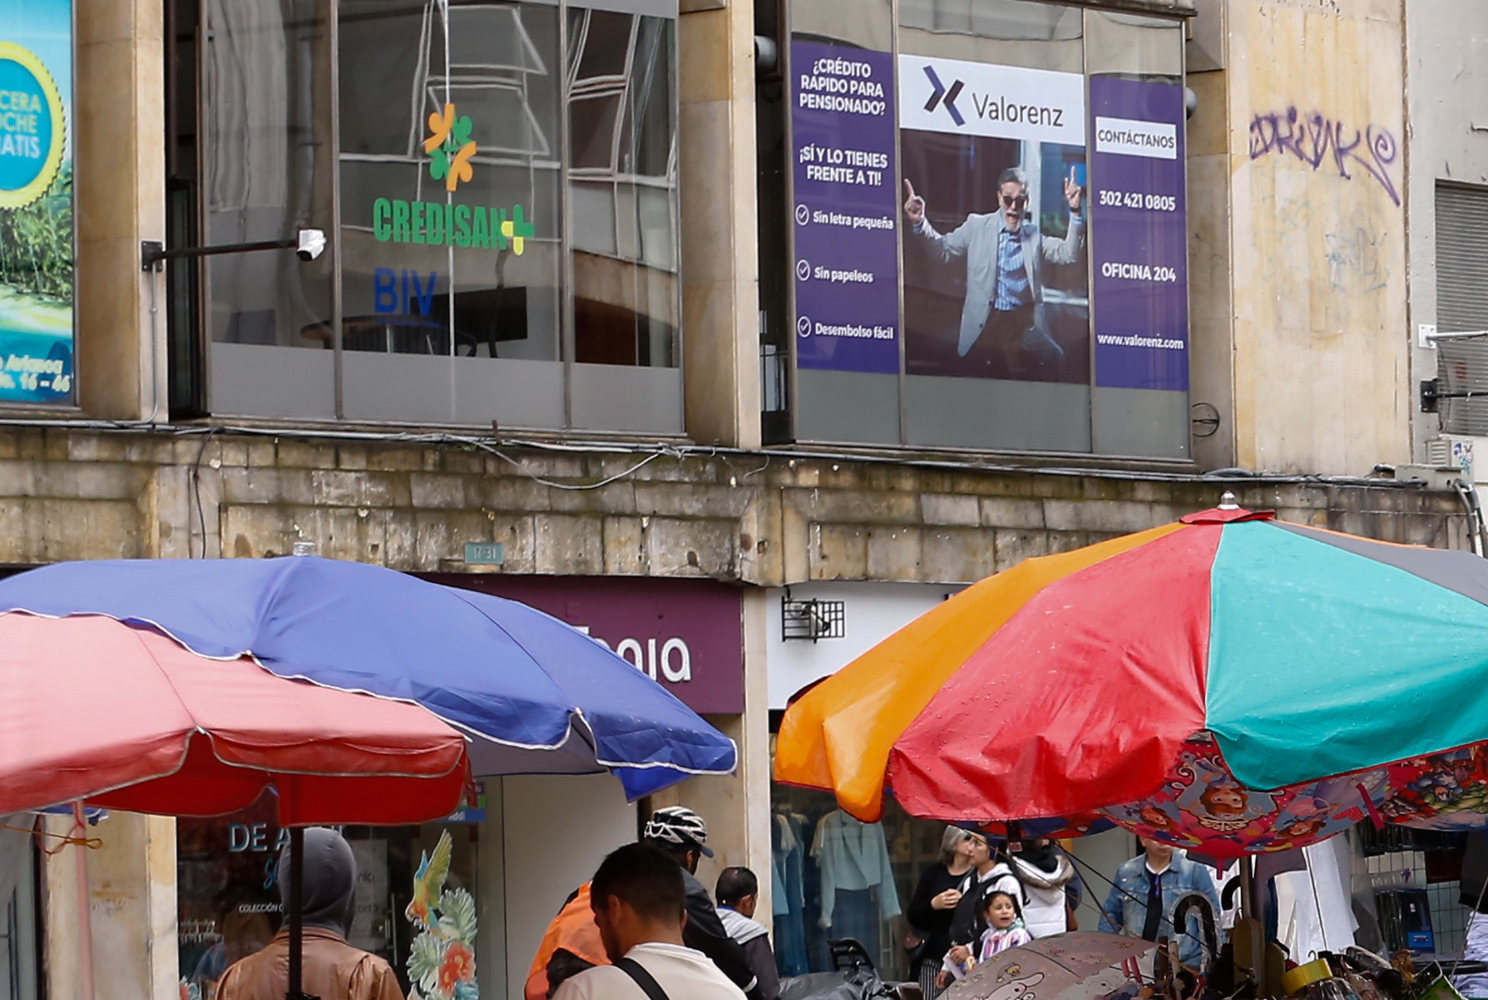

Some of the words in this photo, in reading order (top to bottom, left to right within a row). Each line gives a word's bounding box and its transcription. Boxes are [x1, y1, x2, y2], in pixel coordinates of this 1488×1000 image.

[813, 57, 872, 79] ¿CRÉDITO
[850, 80, 884, 98] PARA
[800, 93, 886, 116] PENSIONADO?
[972, 93, 1063, 127] Valorenz
[0, 112, 38, 134] CHE
[0, 133, 40, 158] ATIS
[1098, 129, 1175, 149] CONTÁCTANOS
[800, 143, 815, 164] ¡SÍ
[816, 148, 826, 163] Y
[827, 148, 843, 164] LO
[844, 150, 888, 168] TIENES
[807, 165, 854, 183] FRENTE
[856, 170, 866, 185] A
[867, 171, 882, 186] TI!
[1099, 190, 1122, 206] 302
[1124, 192, 1142, 208] 421
[1145, 194, 1176, 212] 0805
[830, 212, 851, 226] letra
[853, 216, 894, 230] pequeña
[831, 270, 874, 284] papeleos
[1102, 262, 1152, 280] OFICINA
[1153, 266, 1176, 282] 204
[374, 267, 438, 317] BIV
[815, 323, 872, 338] Desembolso
[874, 326, 894, 340] fácil
[1097, 334, 1184, 350] www.valorenz.com
[228, 823, 268, 852] DE
